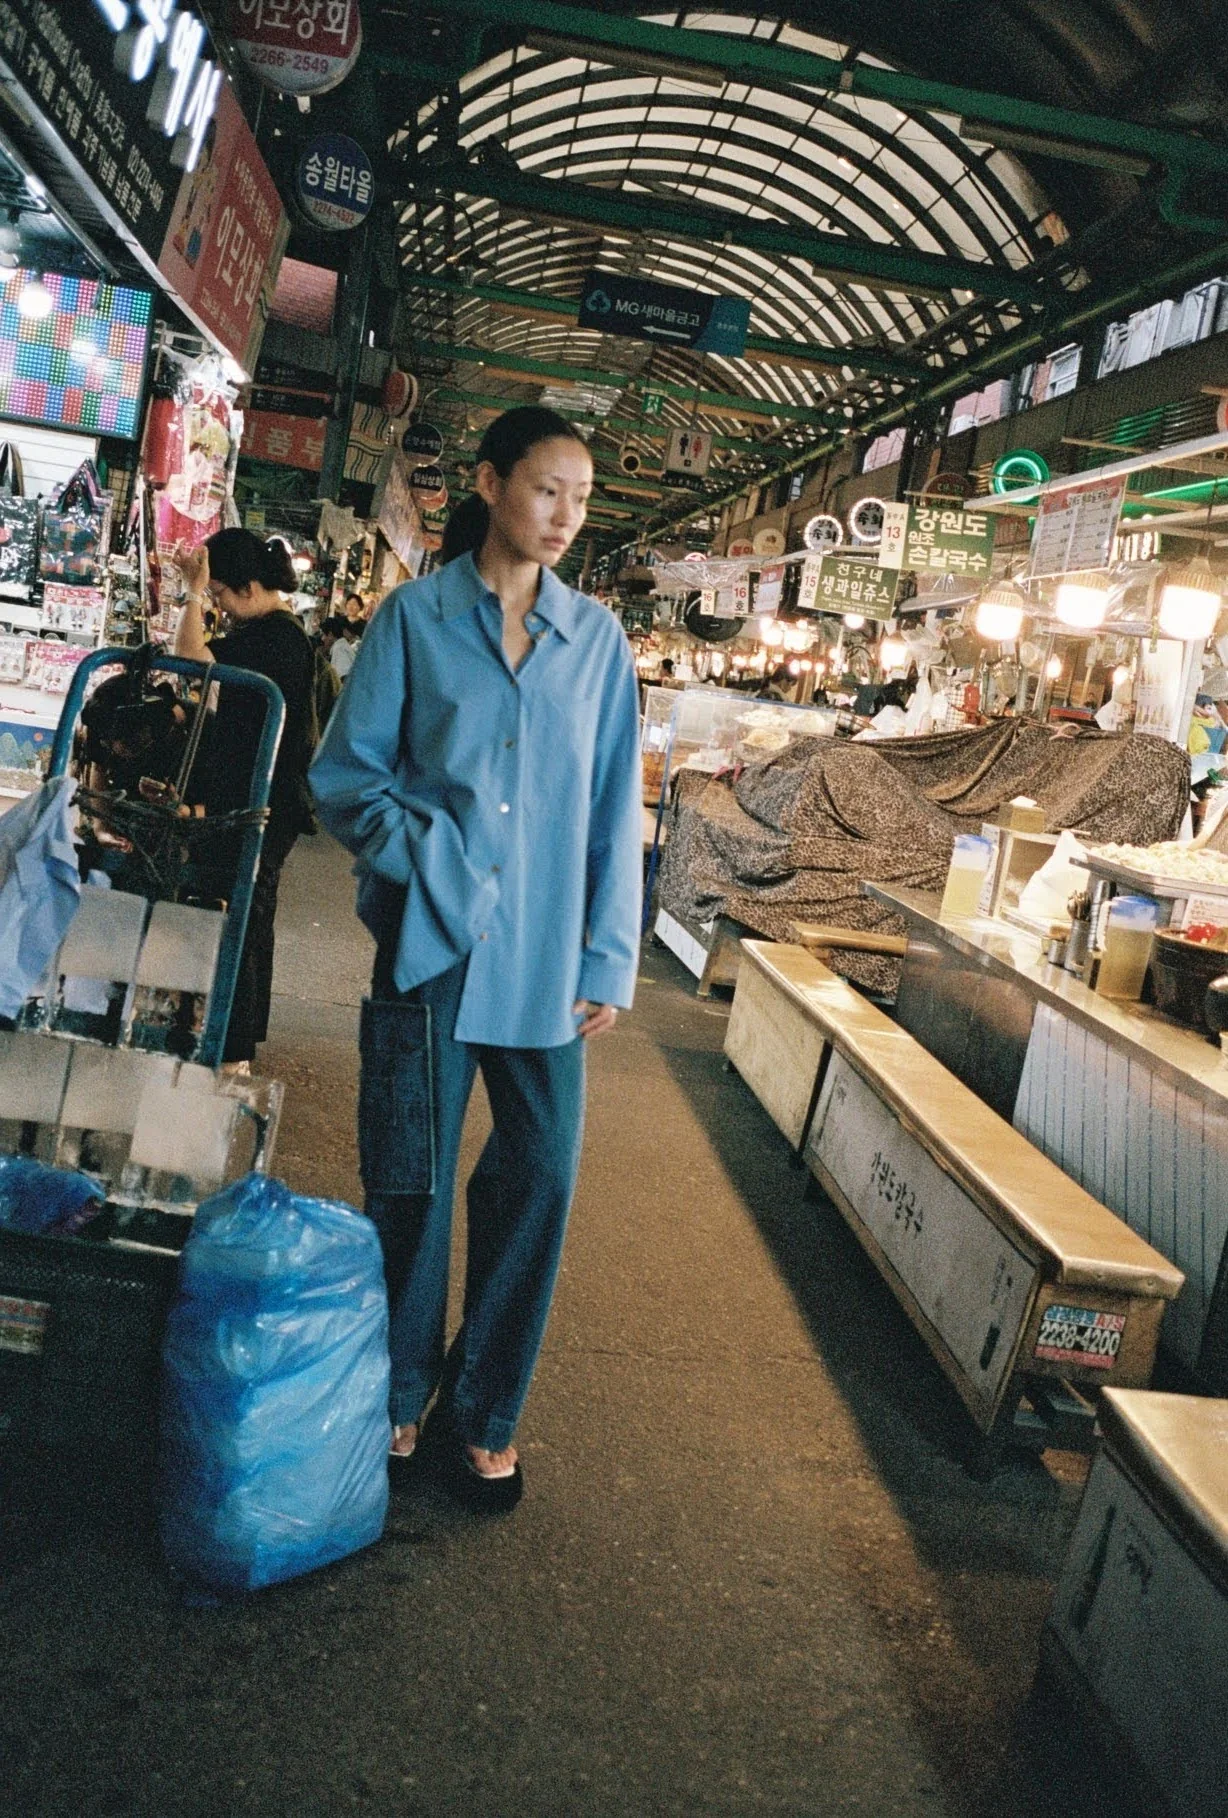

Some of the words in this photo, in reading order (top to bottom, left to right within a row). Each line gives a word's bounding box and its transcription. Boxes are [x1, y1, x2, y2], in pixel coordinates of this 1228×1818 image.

[615, 299, 640, 316] MG
[641, 305, 700, 327] 새마을금고
[886, 526, 900, 539] 13
[915, 509, 988, 537] 강원도
[908, 531, 935, 546] 원조
[908, 546, 987, 572] 손칼국수
[804, 576, 816, 587] 15
[821, 575, 890, 604] 생과일쥬스
[703, 593, 712, 601] 16
[734, 587, 747, 598] 16
[1038, 1321, 1120, 1356] 2238-4200
